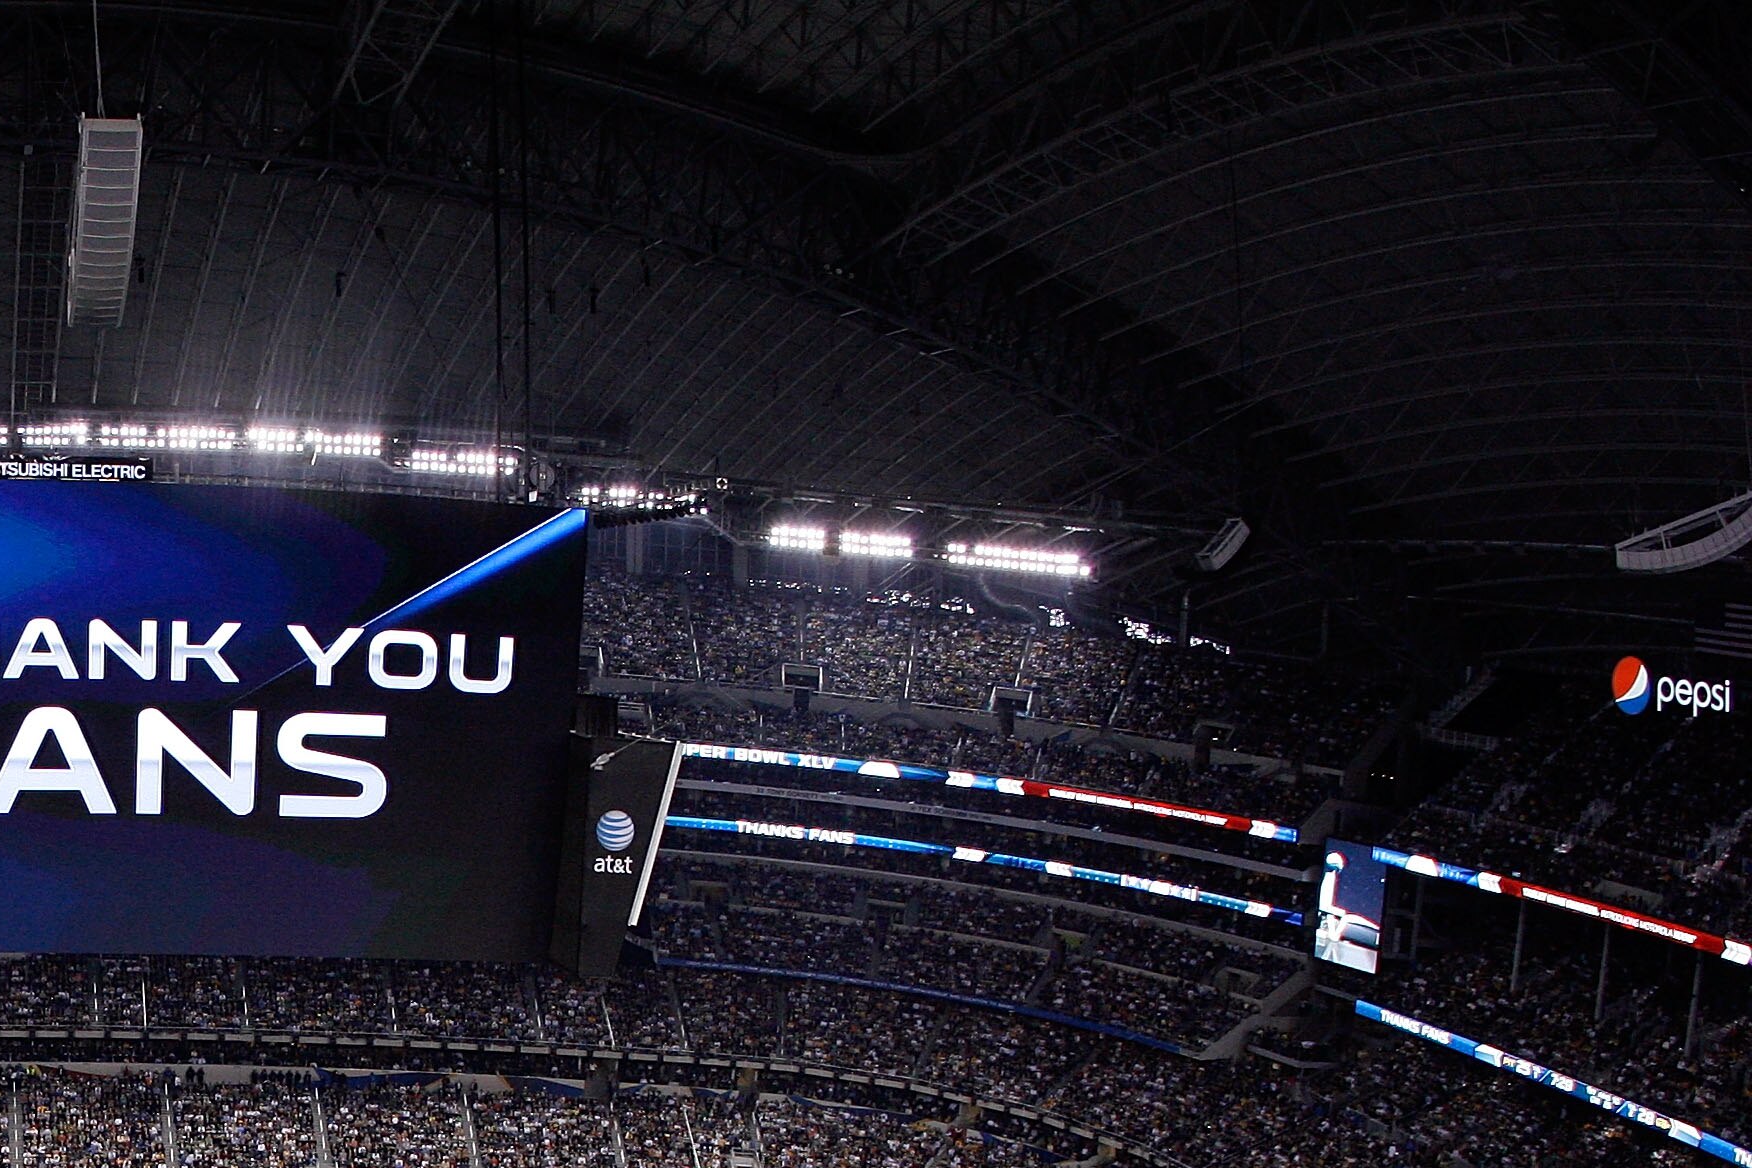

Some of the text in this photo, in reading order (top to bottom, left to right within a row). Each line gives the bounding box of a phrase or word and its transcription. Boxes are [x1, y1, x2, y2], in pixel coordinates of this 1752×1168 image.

[71, 464, 146, 479] ELECTRIC
[285, 623, 516, 695] YOU
[1656, 676, 1731, 718] pepsi
[734, 747, 789, 766] BOWL
[796, 753, 838, 770] XLV
[735, 819, 857, 846] THANKS FANS
[593, 855, 633, 875] at&t
[1379, 1008, 1450, 1046] THANKS FANS
